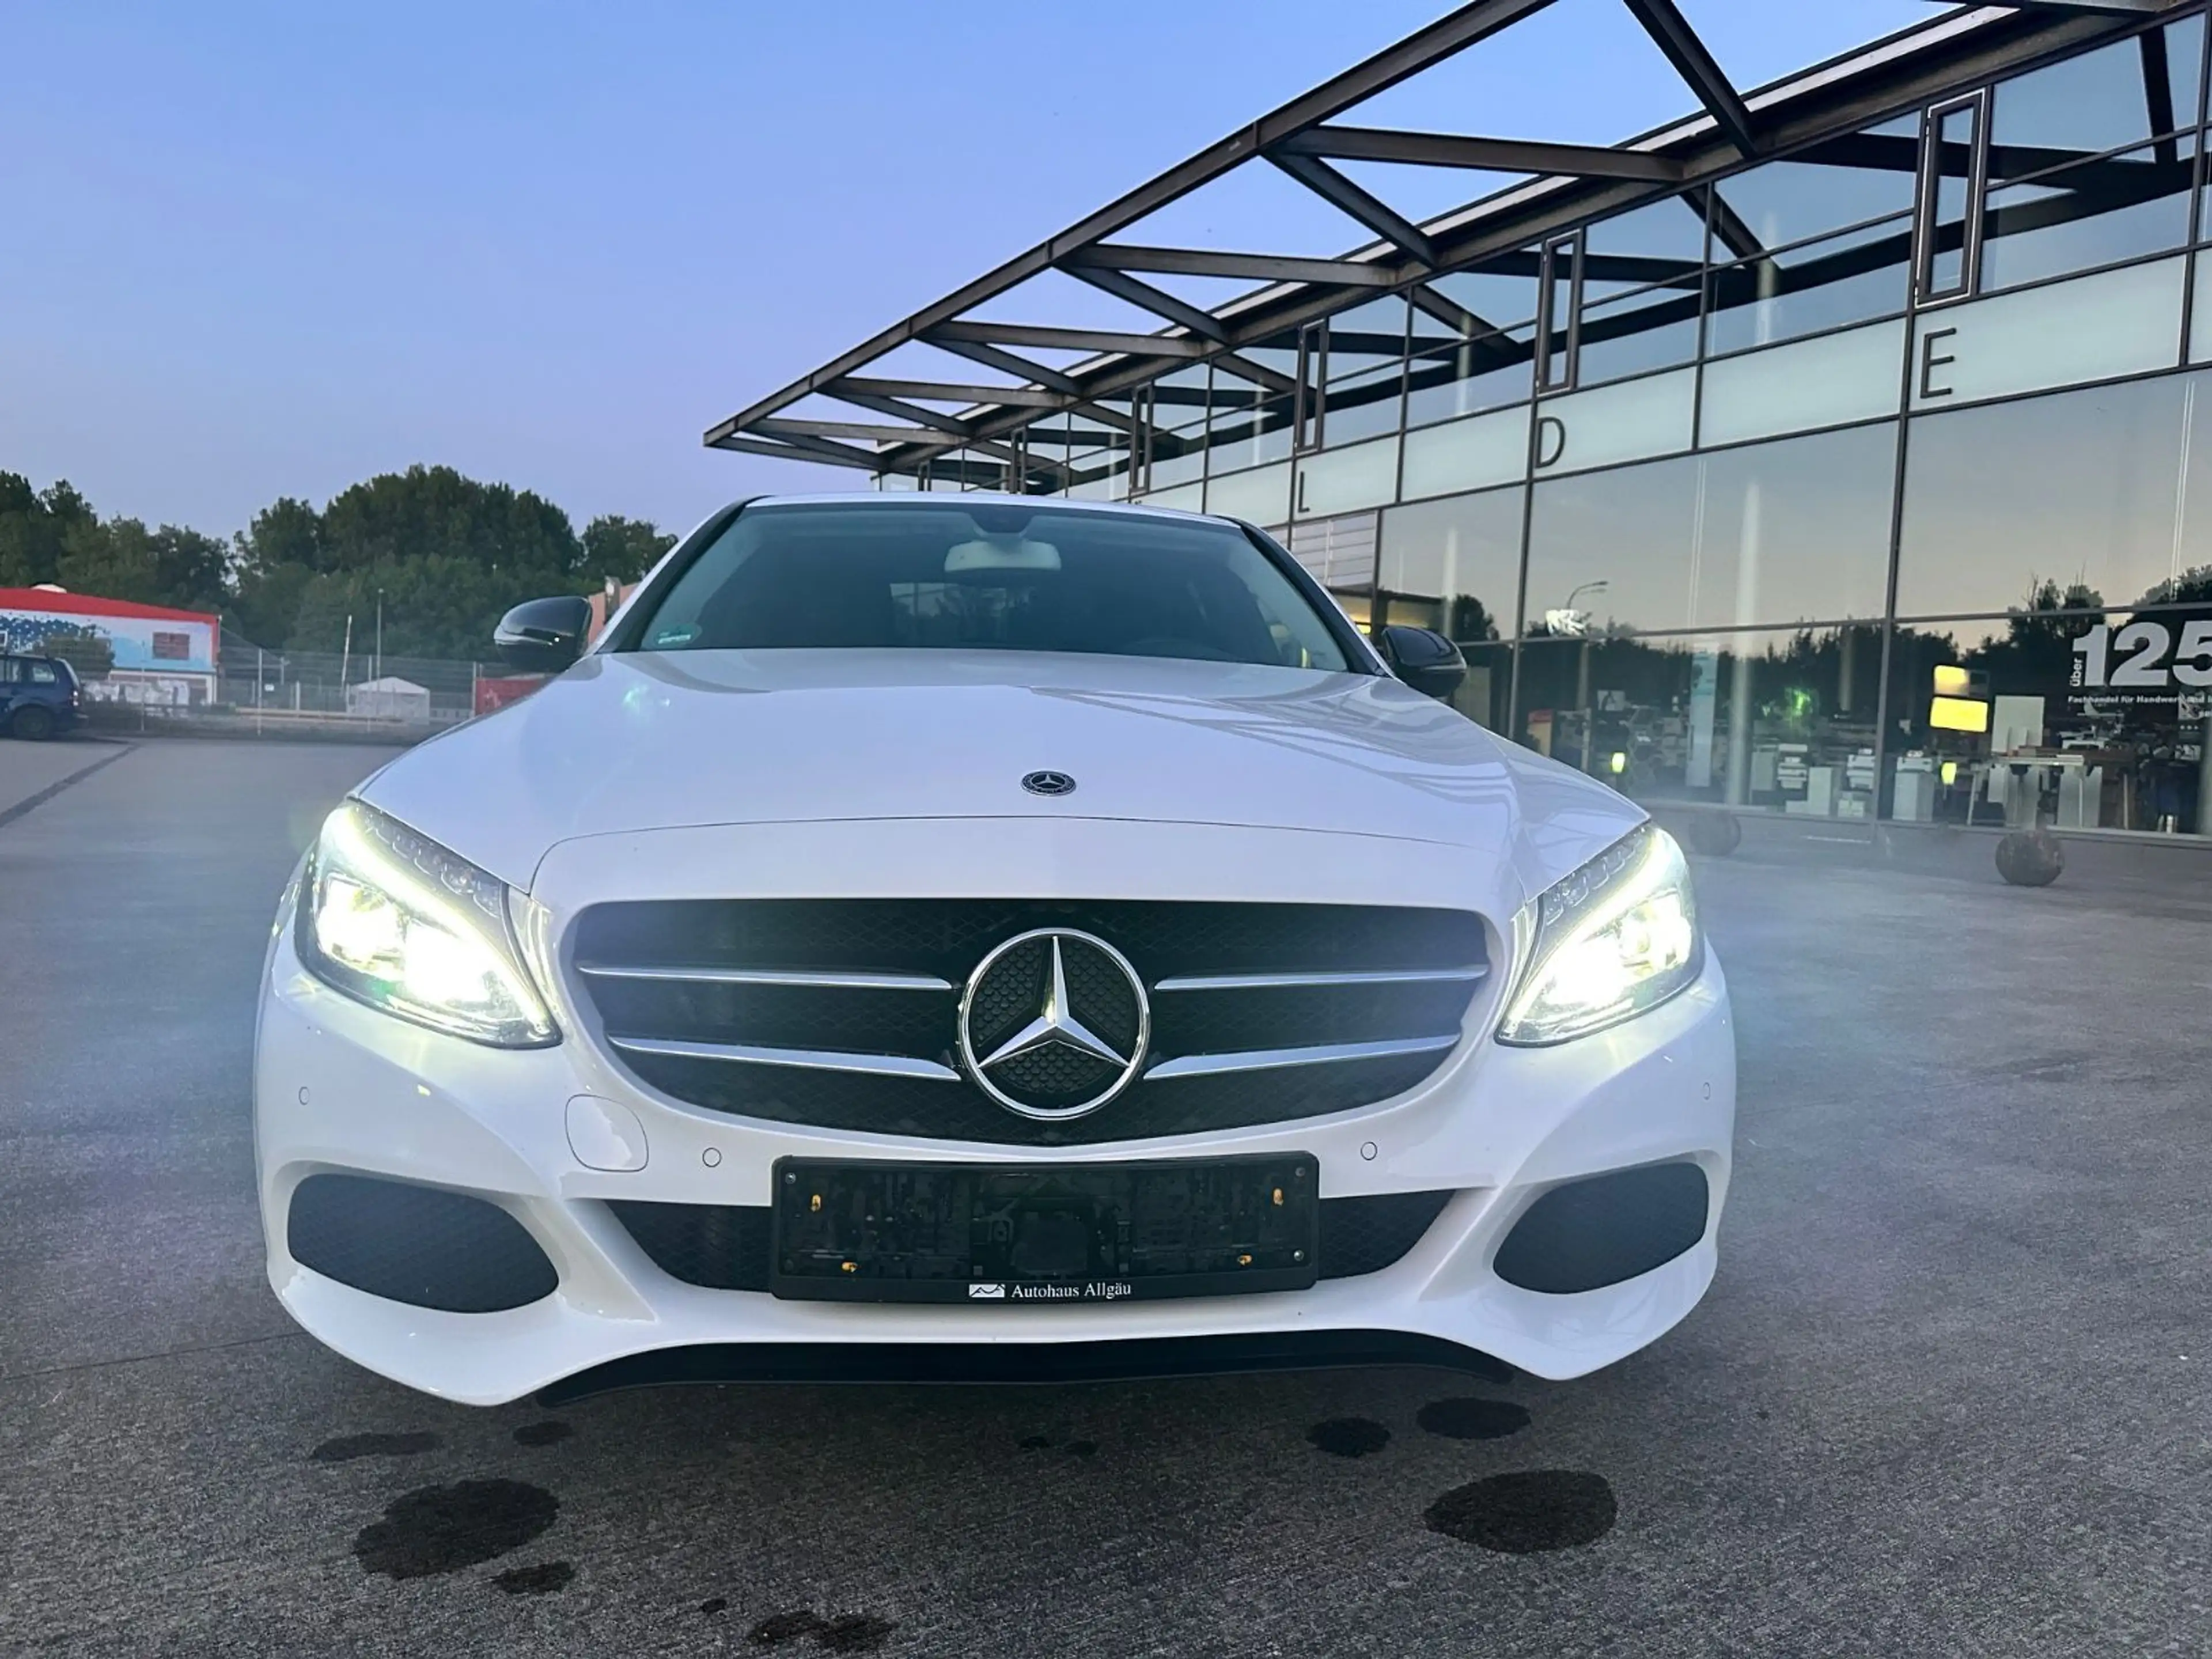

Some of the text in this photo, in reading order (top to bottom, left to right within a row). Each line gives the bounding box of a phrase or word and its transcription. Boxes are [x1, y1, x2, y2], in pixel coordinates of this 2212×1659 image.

[2072, 620, 2212, 687] 125
[2069, 657, 2083, 687] über
[1012, 1282, 1131, 1300] Autohaus Allgäu
